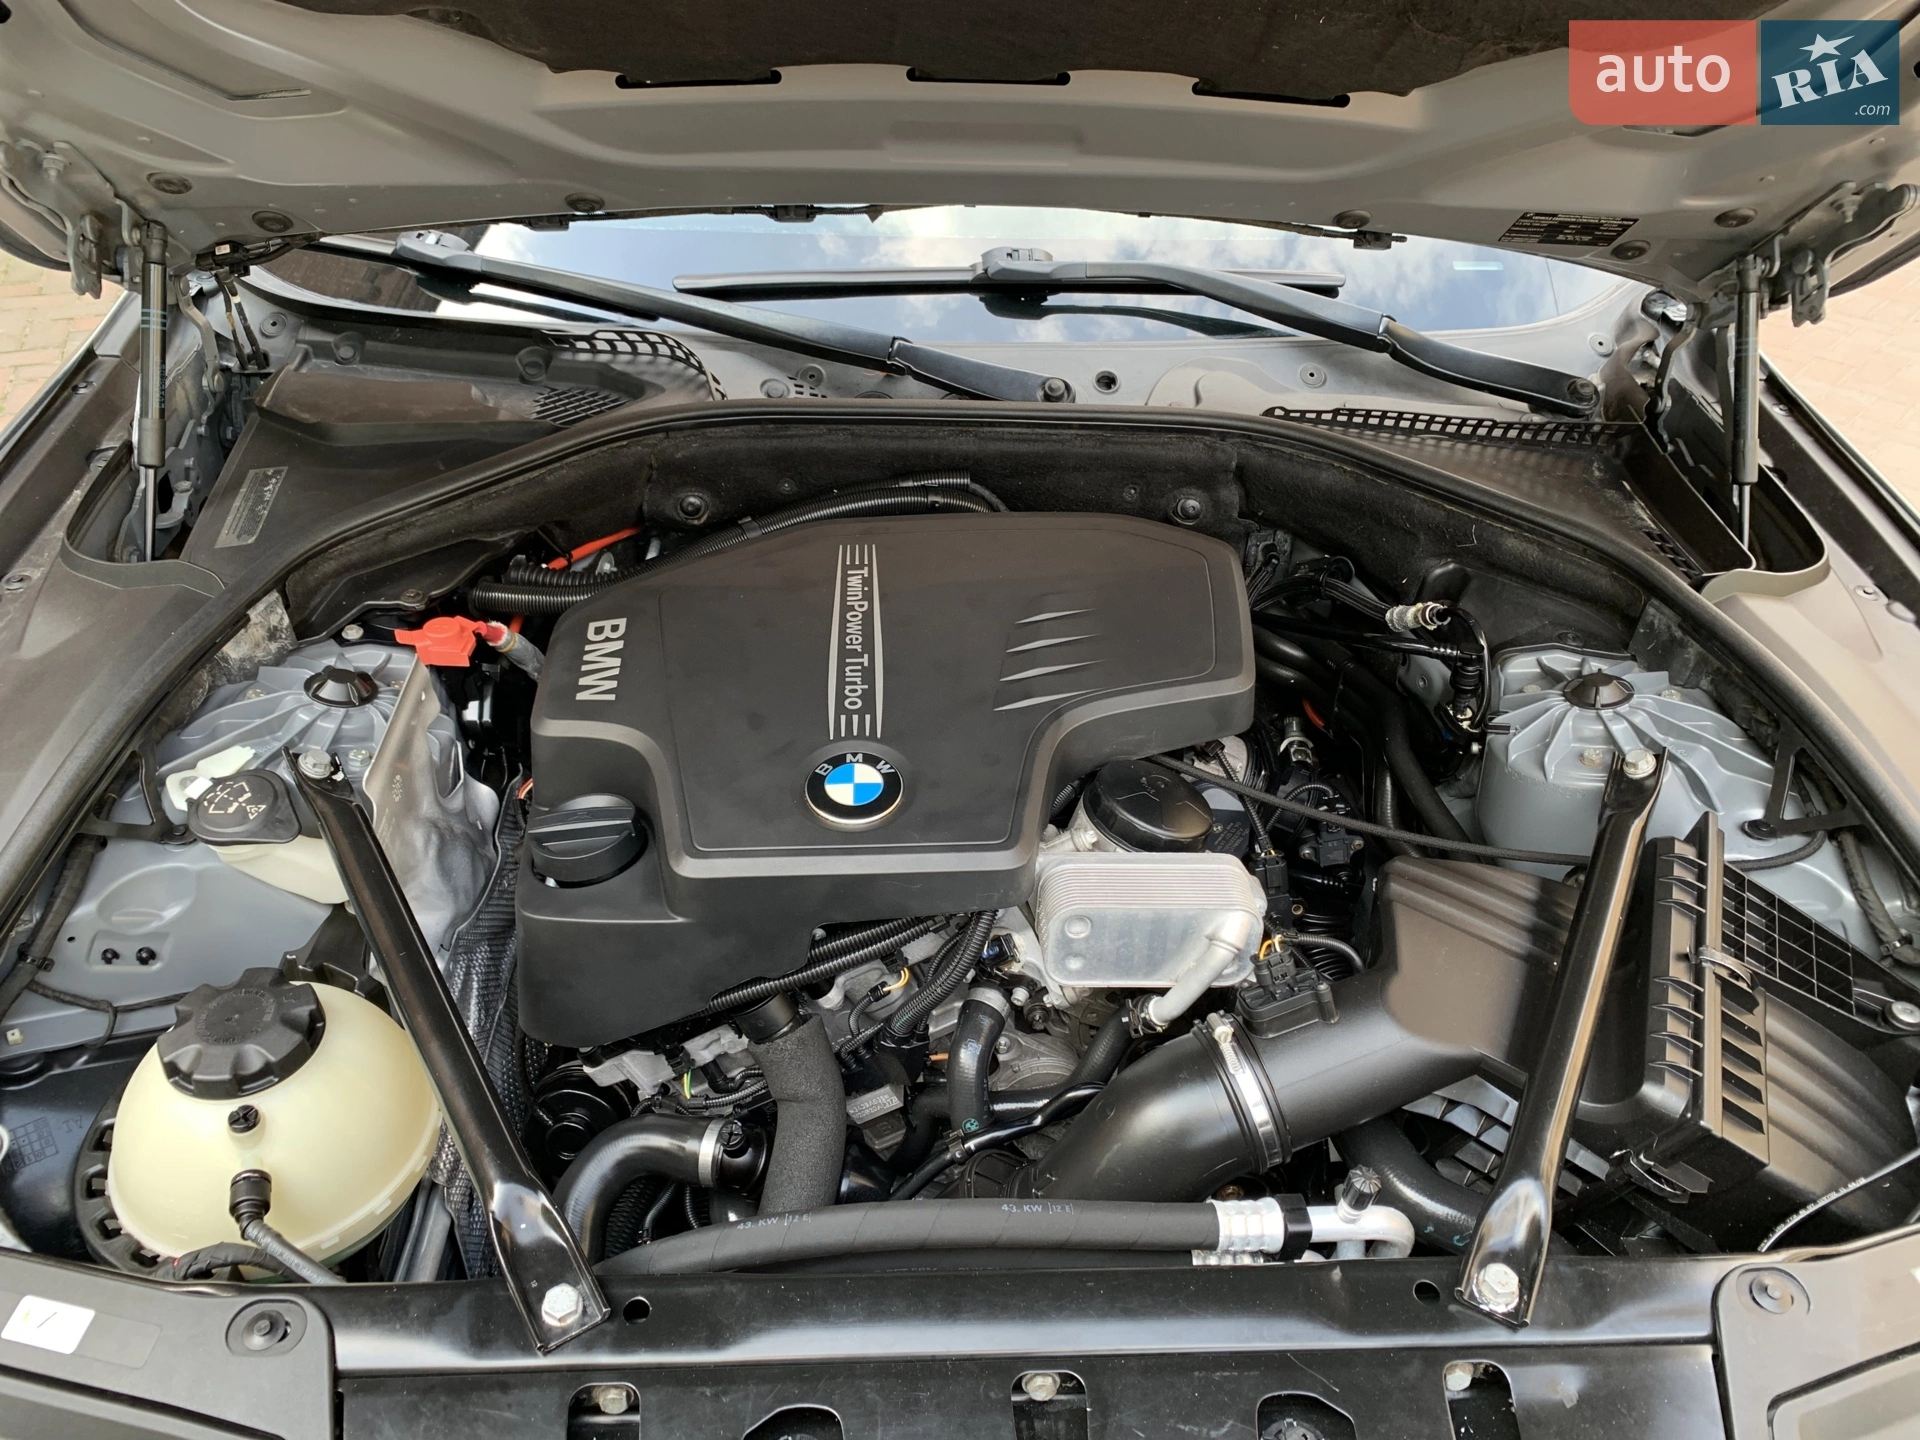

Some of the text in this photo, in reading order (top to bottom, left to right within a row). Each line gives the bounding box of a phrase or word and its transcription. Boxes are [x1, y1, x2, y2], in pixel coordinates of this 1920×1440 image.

[843, 566, 869, 710] TwinPower Turbo
[575, 617, 627, 700] BMW
[814, 753, 896, 777] BMW
[1001, 1203, 1020, 1213] 43.
[1023, 1204, 1043, 1213] KW
[758, 1216, 779, 1226] KW
